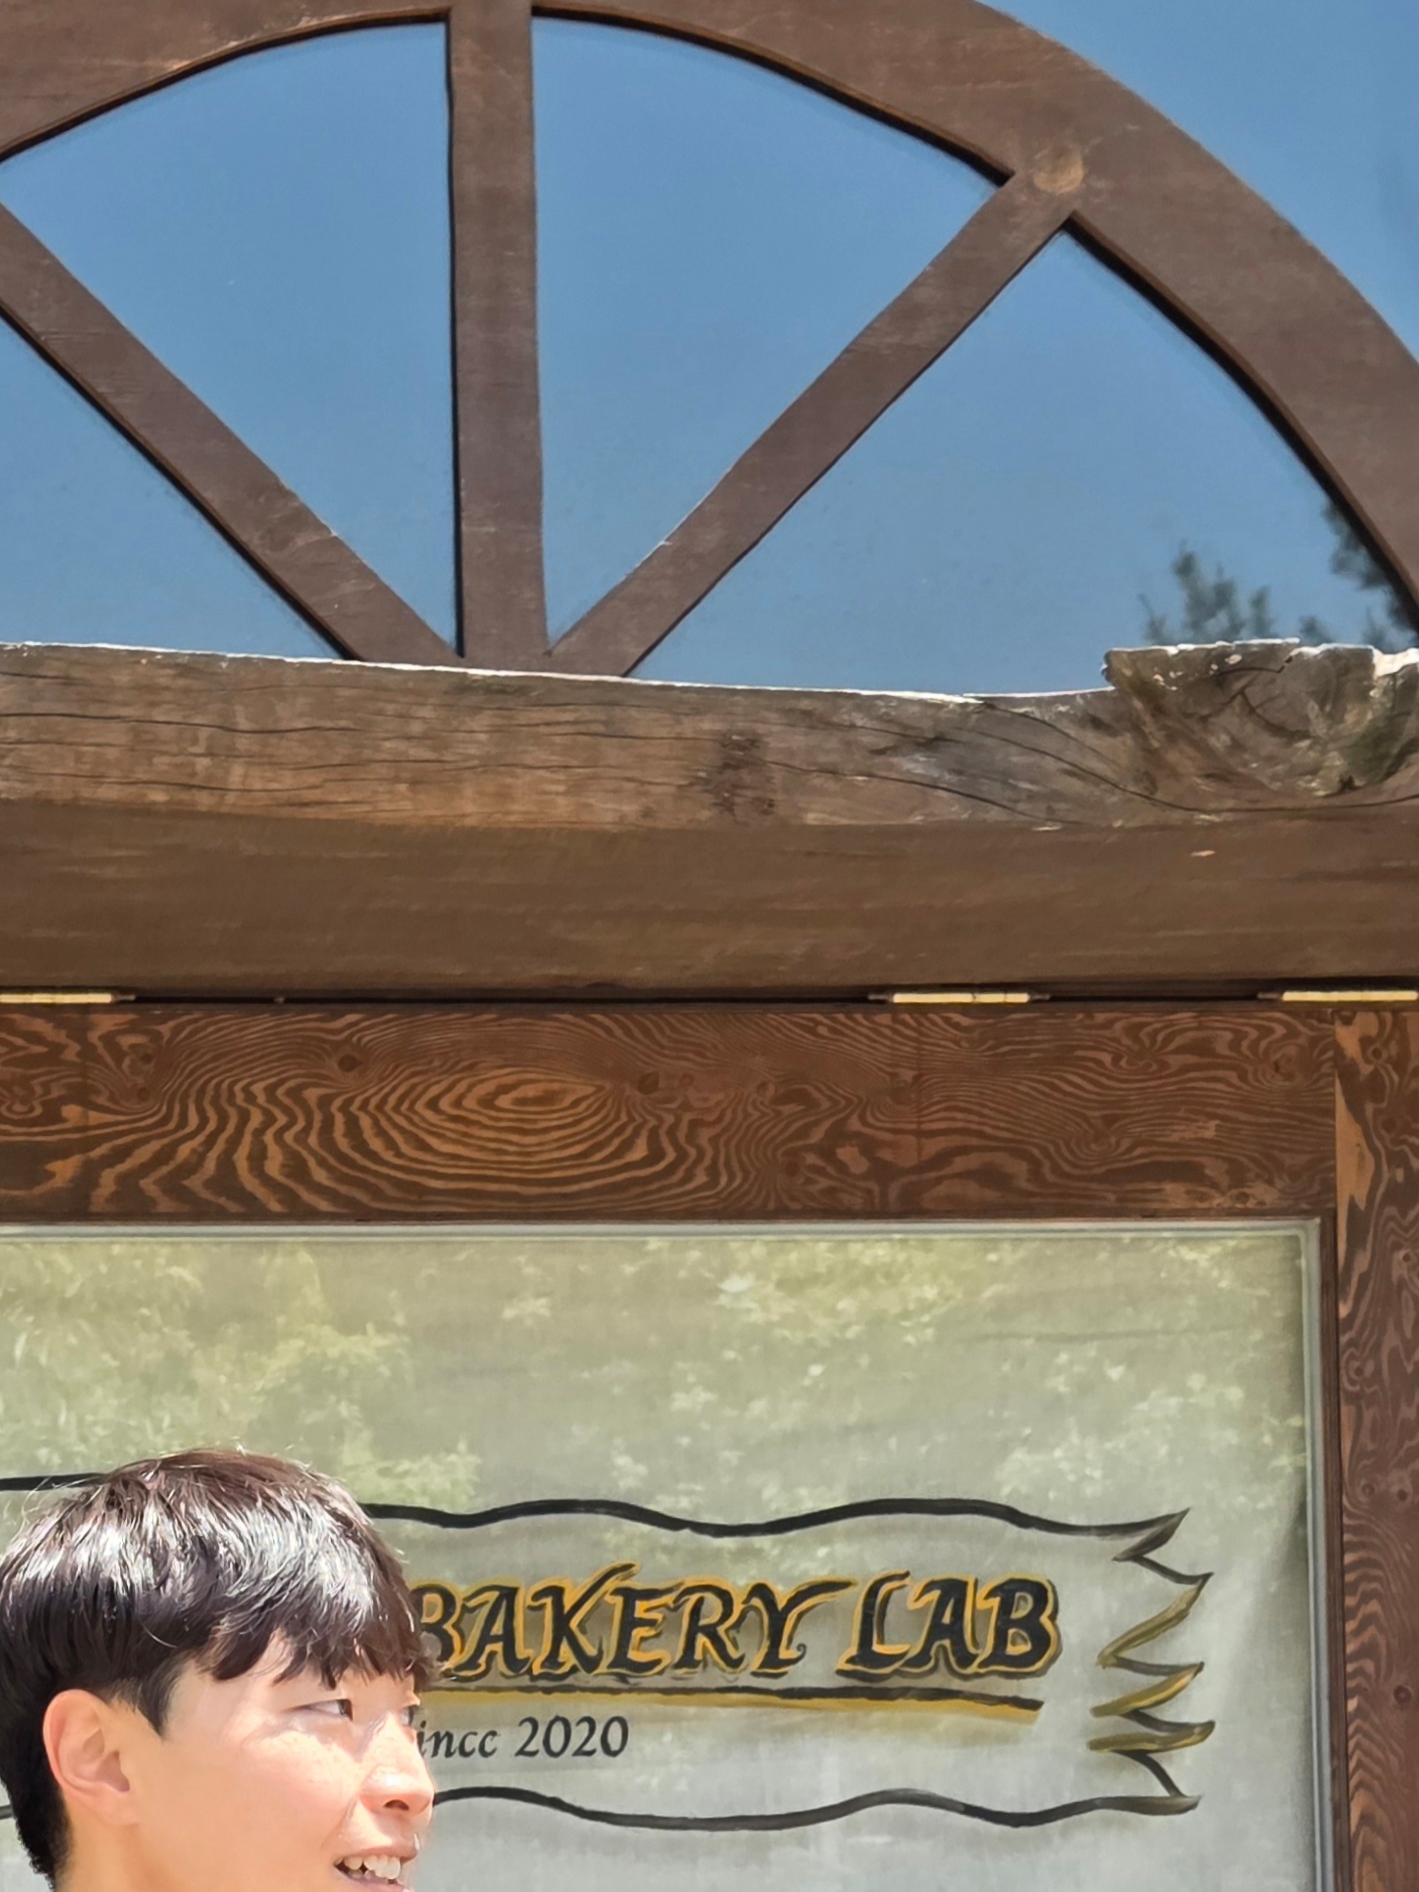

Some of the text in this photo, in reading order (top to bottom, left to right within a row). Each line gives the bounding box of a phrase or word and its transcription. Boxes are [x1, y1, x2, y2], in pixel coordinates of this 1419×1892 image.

[408, 1561, 1063, 1683] BAKERY LAB
[514, 1714, 630, 1759] 2020
